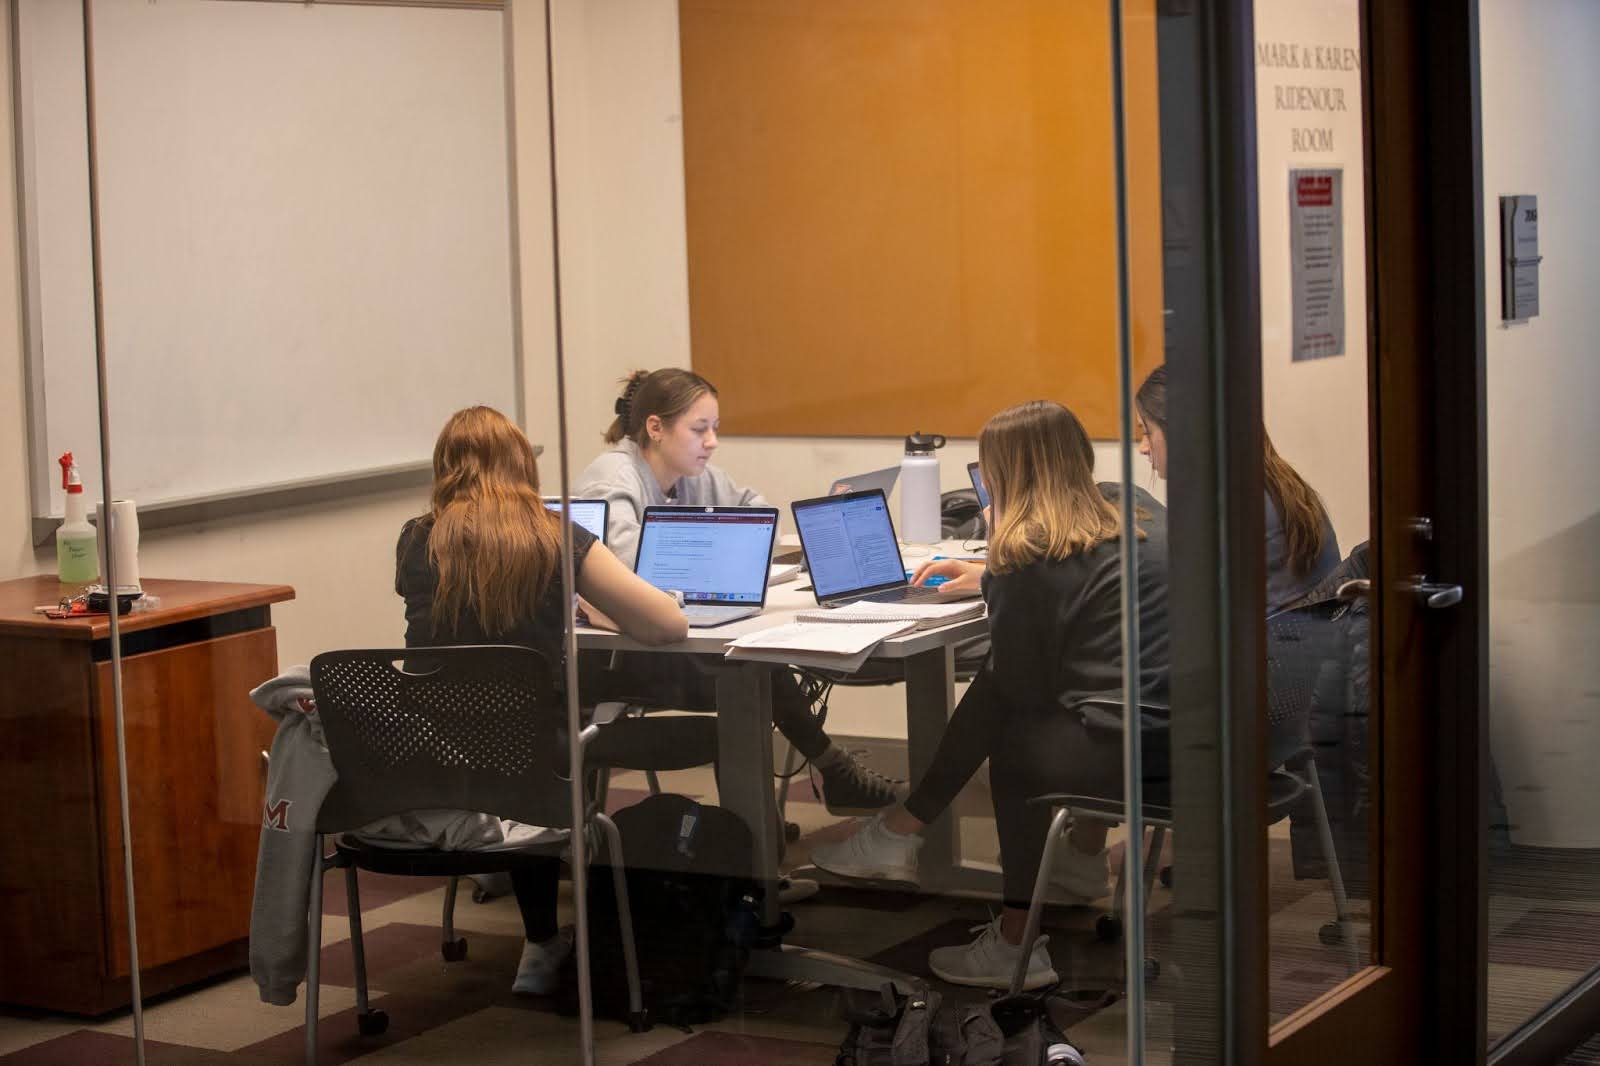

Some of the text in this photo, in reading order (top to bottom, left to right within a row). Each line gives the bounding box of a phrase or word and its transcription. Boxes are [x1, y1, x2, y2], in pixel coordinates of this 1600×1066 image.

[1258, 43, 1300, 69] MARK
[1315, 46, 1361, 72] KAREN
[1274, 85, 1347, 112] RIDENOUR
[1291, 127, 1334, 153] ROOM
[263, 799, 292, 832] M
